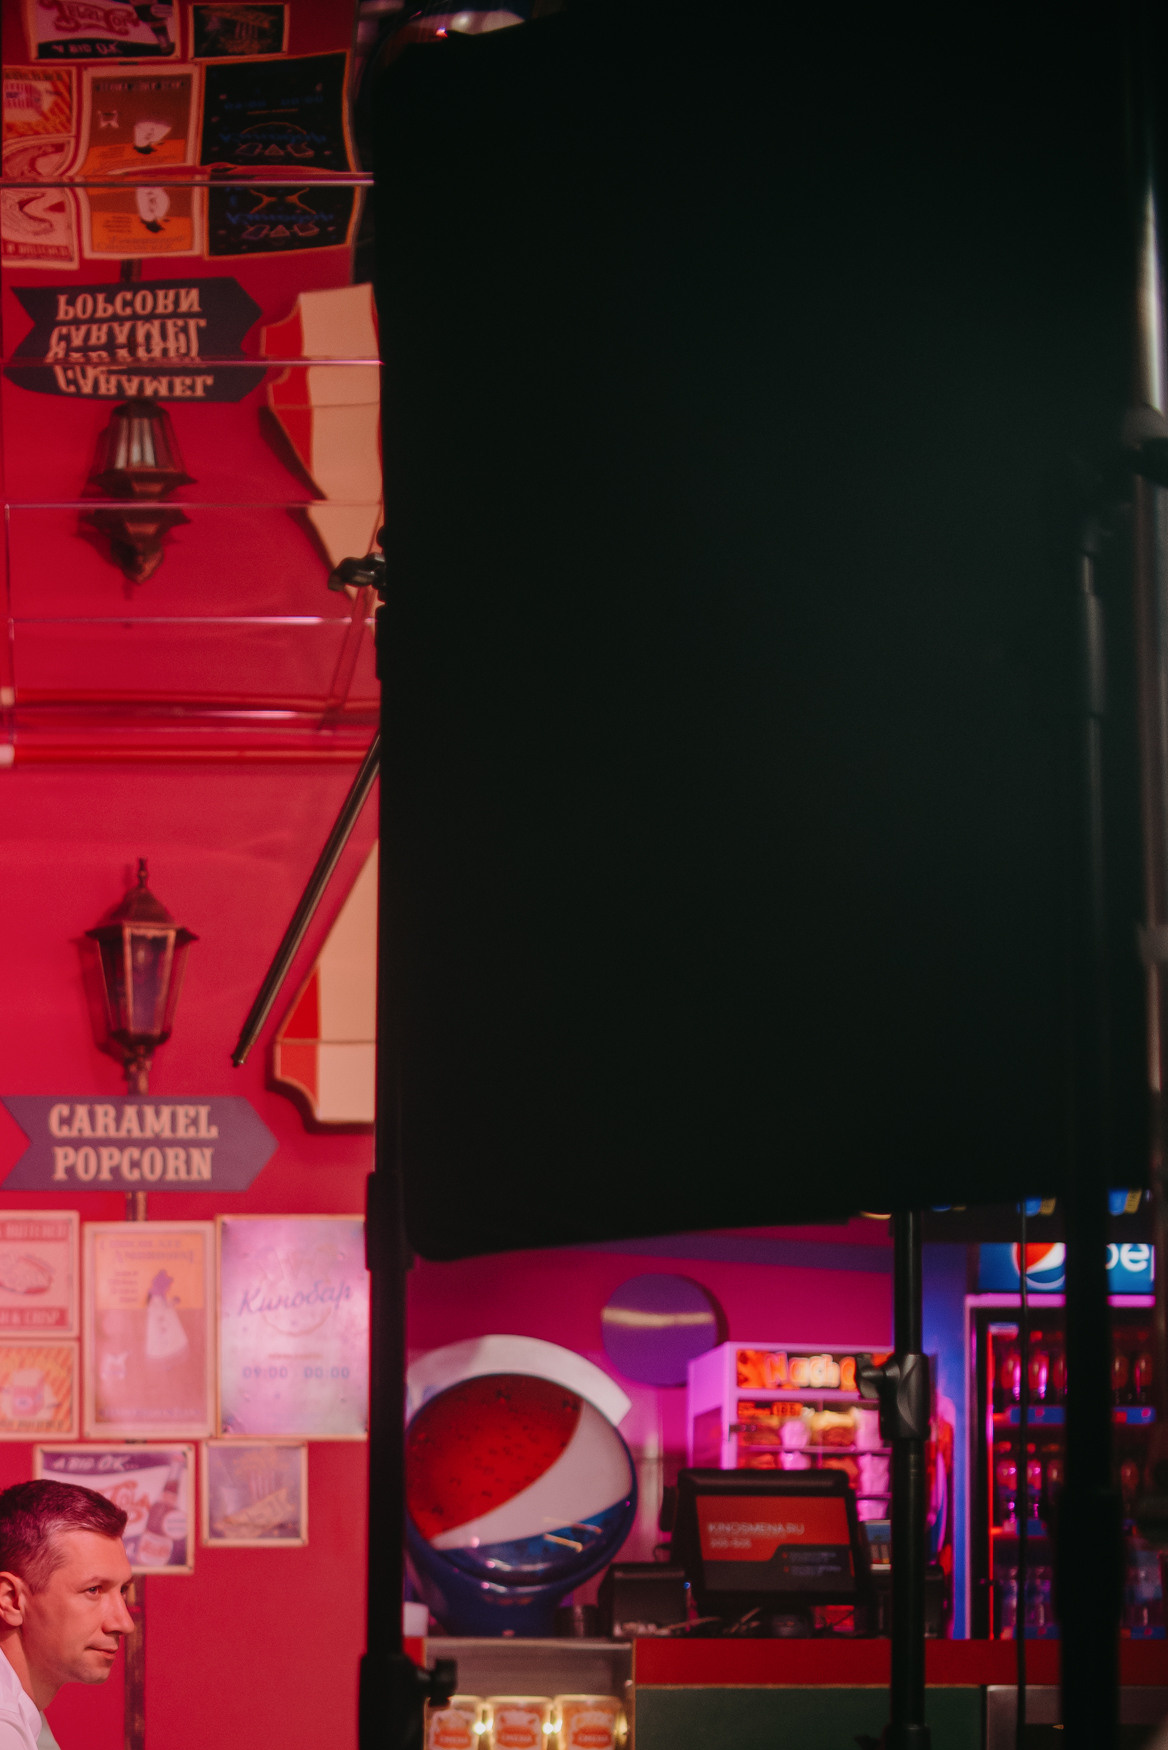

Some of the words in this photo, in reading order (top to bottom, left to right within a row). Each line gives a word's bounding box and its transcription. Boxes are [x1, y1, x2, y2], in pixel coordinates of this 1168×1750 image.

[49, 1104, 219, 1139] CARAMEL
[53, 1146, 214, 1181] POPCORN
[239, 1280, 352, 1316] Кинобар
[242, 1366, 288, 1379] 09:00
[304, 1366, 351, 1380] 00:00
